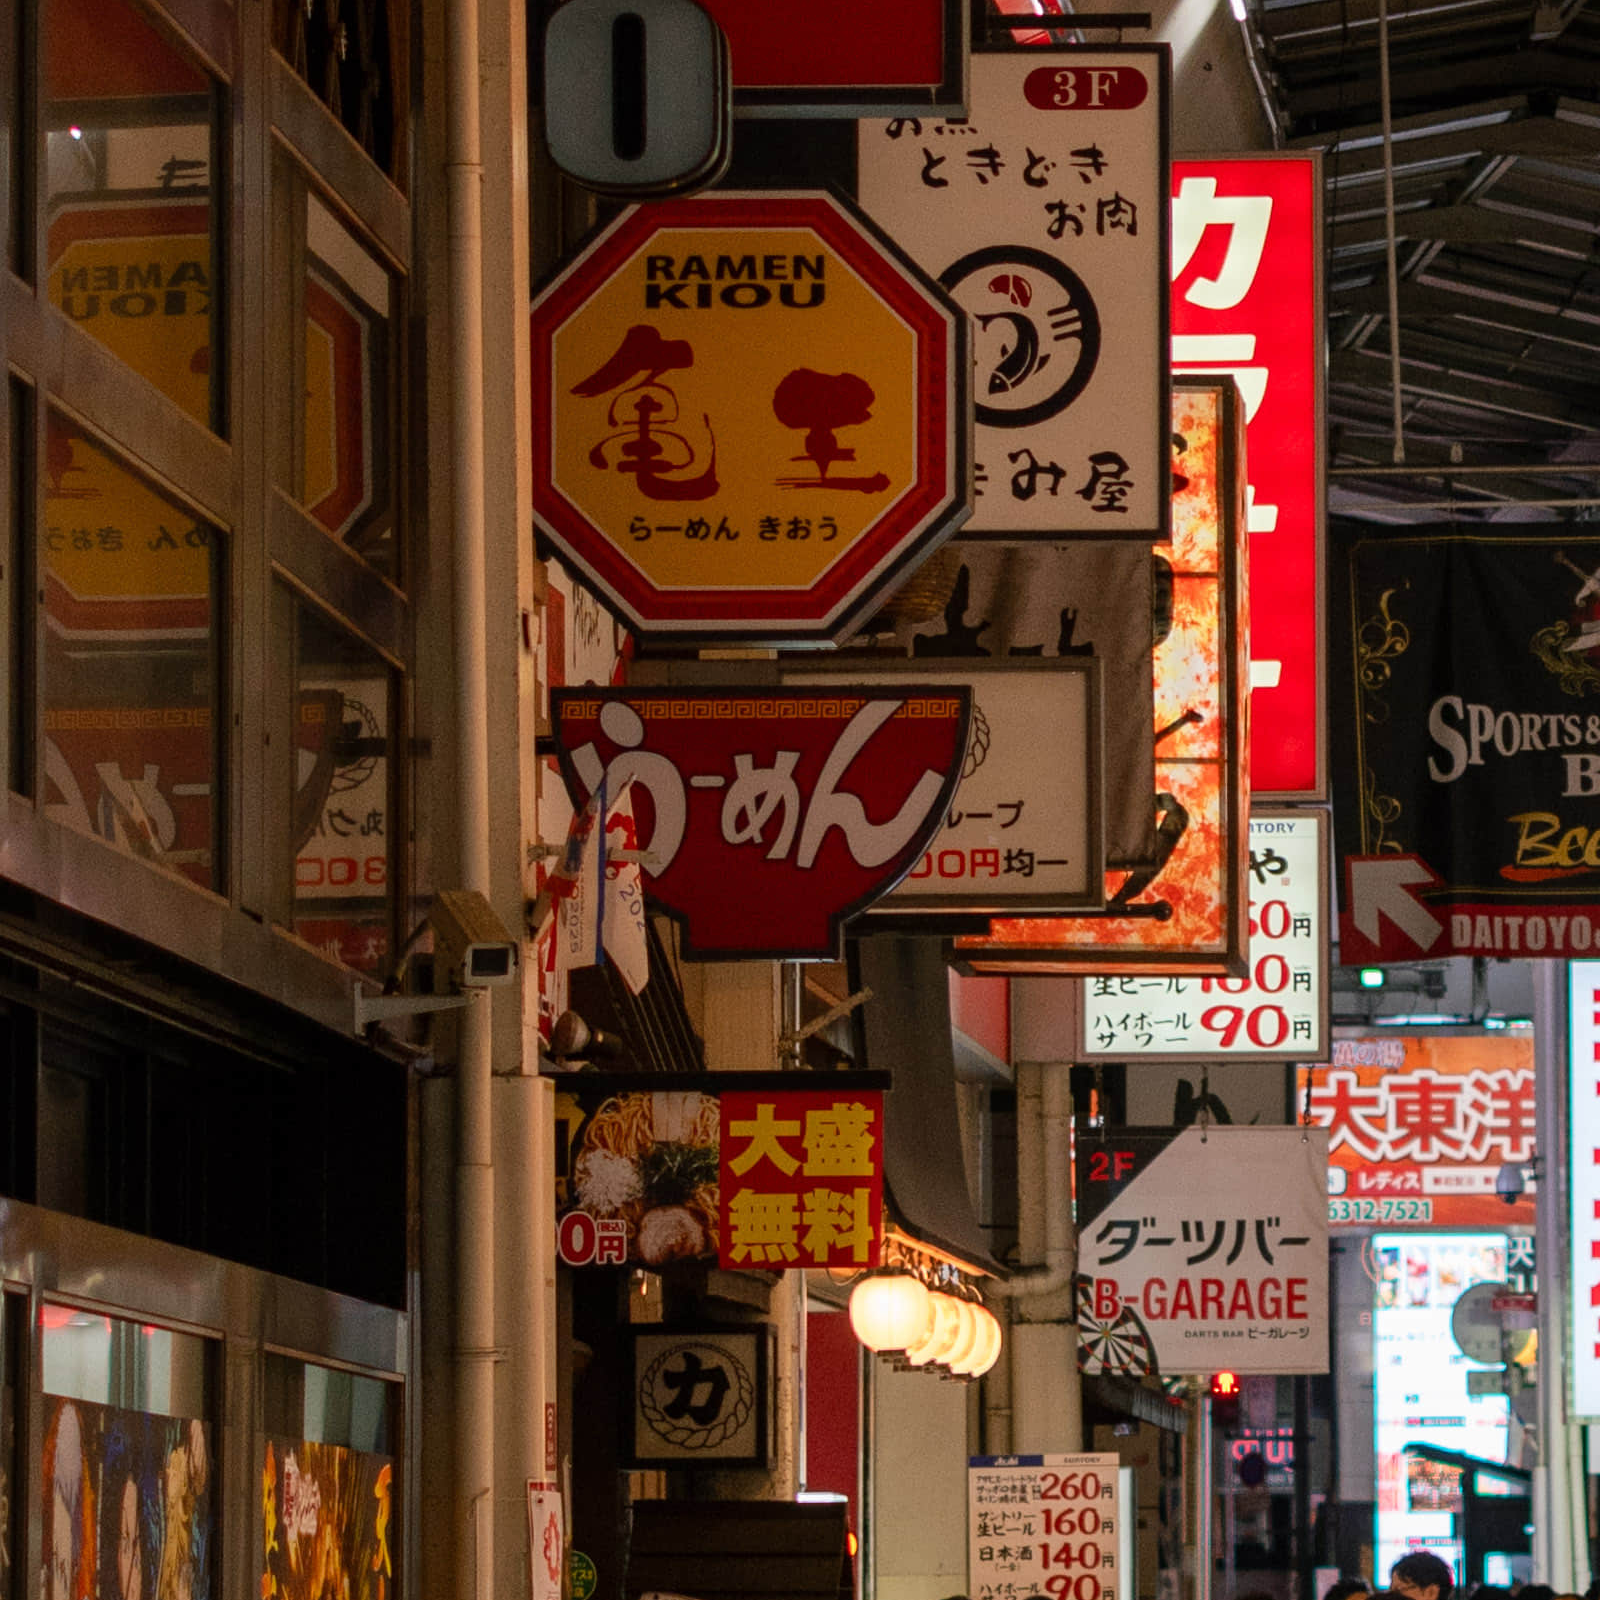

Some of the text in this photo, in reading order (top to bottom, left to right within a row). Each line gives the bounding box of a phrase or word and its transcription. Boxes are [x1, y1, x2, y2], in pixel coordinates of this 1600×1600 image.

[1053, 71, 1119, 107] 3F
[920, 143, 1109, 188] ときどき
[1043, 192, 1138, 239] お肉
[646, 255, 825, 280] RAMEN
[644, 283, 826, 310] KIOU
[629, 515, 839, 542] らーめん きおう
[570, 700, 946, 878] らーめん
[1095, 1012, 1192, 1031] ハイボール
[1097, 1032, 1188, 1049] サワー
[1302, 1071, 1536, 1161] 大東洋
[728, 1102, 876, 1178] 大盛
[1089, 1151, 1135, 1181] 2F
[1359, 1172, 1421, 1189] レディス
[728, 1187, 876, 1264] 無料
[1096, 1217, 1311, 1267] ダーツバー
[1094, 1276, 1308, 1321] B-GARAGE
[977, 1522, 1036, 1537] 生ビール
[978, 1511, 1037, 1521] サントリー
[979, 1545, 1033, 1561] 日本酒
